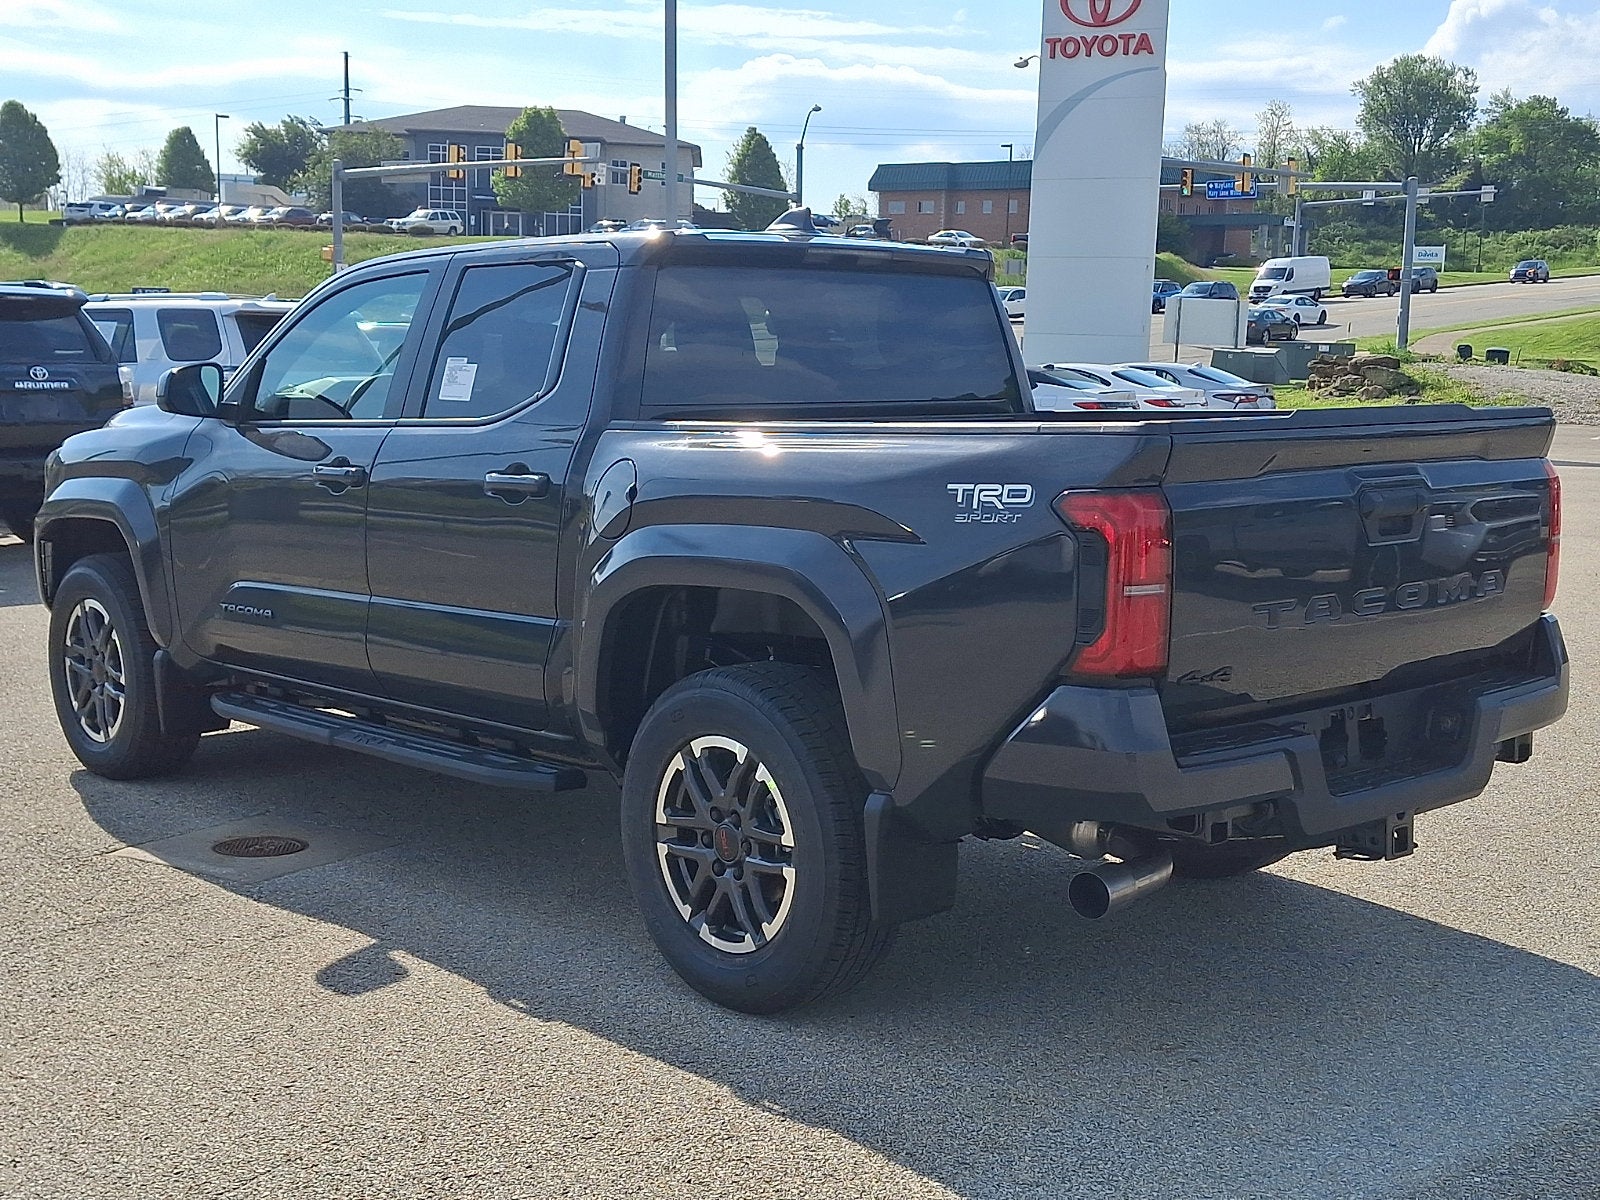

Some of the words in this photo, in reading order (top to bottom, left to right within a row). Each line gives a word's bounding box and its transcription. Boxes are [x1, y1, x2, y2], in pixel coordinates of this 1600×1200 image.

[1045, 33, 1154, 59] TOYOTA
[14, 380, 69, 389] 4RUNNER
[946, 483, 1034, 509] TRD
[954, 513, 1022, 523] SPORT
[1252, 568, 1508, 630] TACOMA
[219, 603, 272, 618] TACOMA
